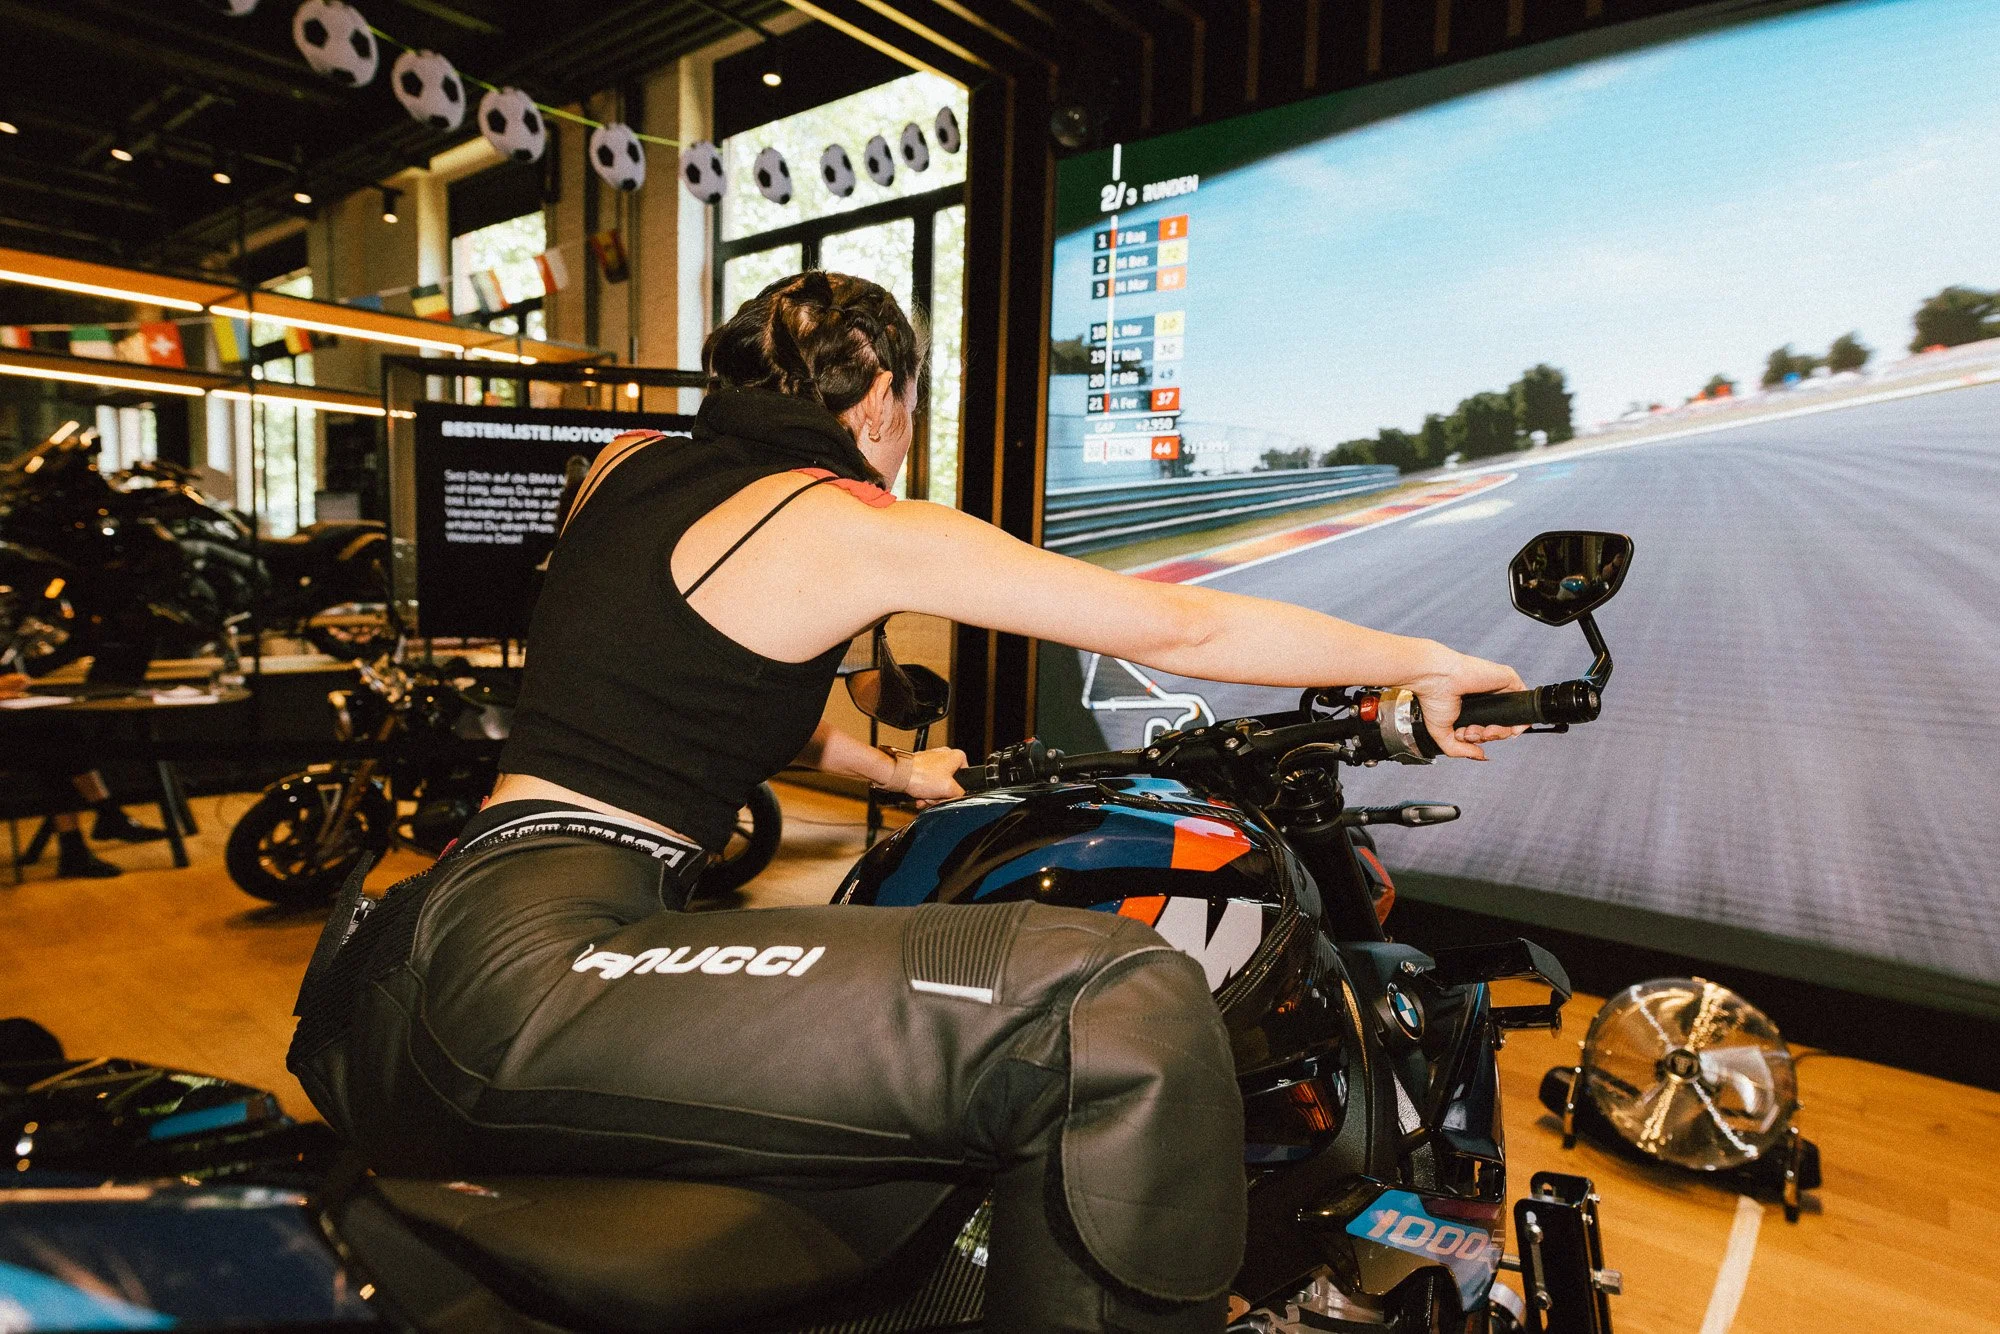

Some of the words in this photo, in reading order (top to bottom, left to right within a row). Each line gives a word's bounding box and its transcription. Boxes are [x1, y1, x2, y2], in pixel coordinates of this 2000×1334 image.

[1142, 174, 1199, 203] RUNDEN
[1097, 233, 1108, 249] 1
[1096, 258, 1107, 273] 2
[1095, 282, 1106, 298] 3
[1090, 349, 1106, 365] 19
[1088, 397, 1104, 411] 21
[1156, 391, 1175, 406] 37
[441, 420, 552, 441] BESTENLISTE
[1153, 441, 1173, 456] 44
